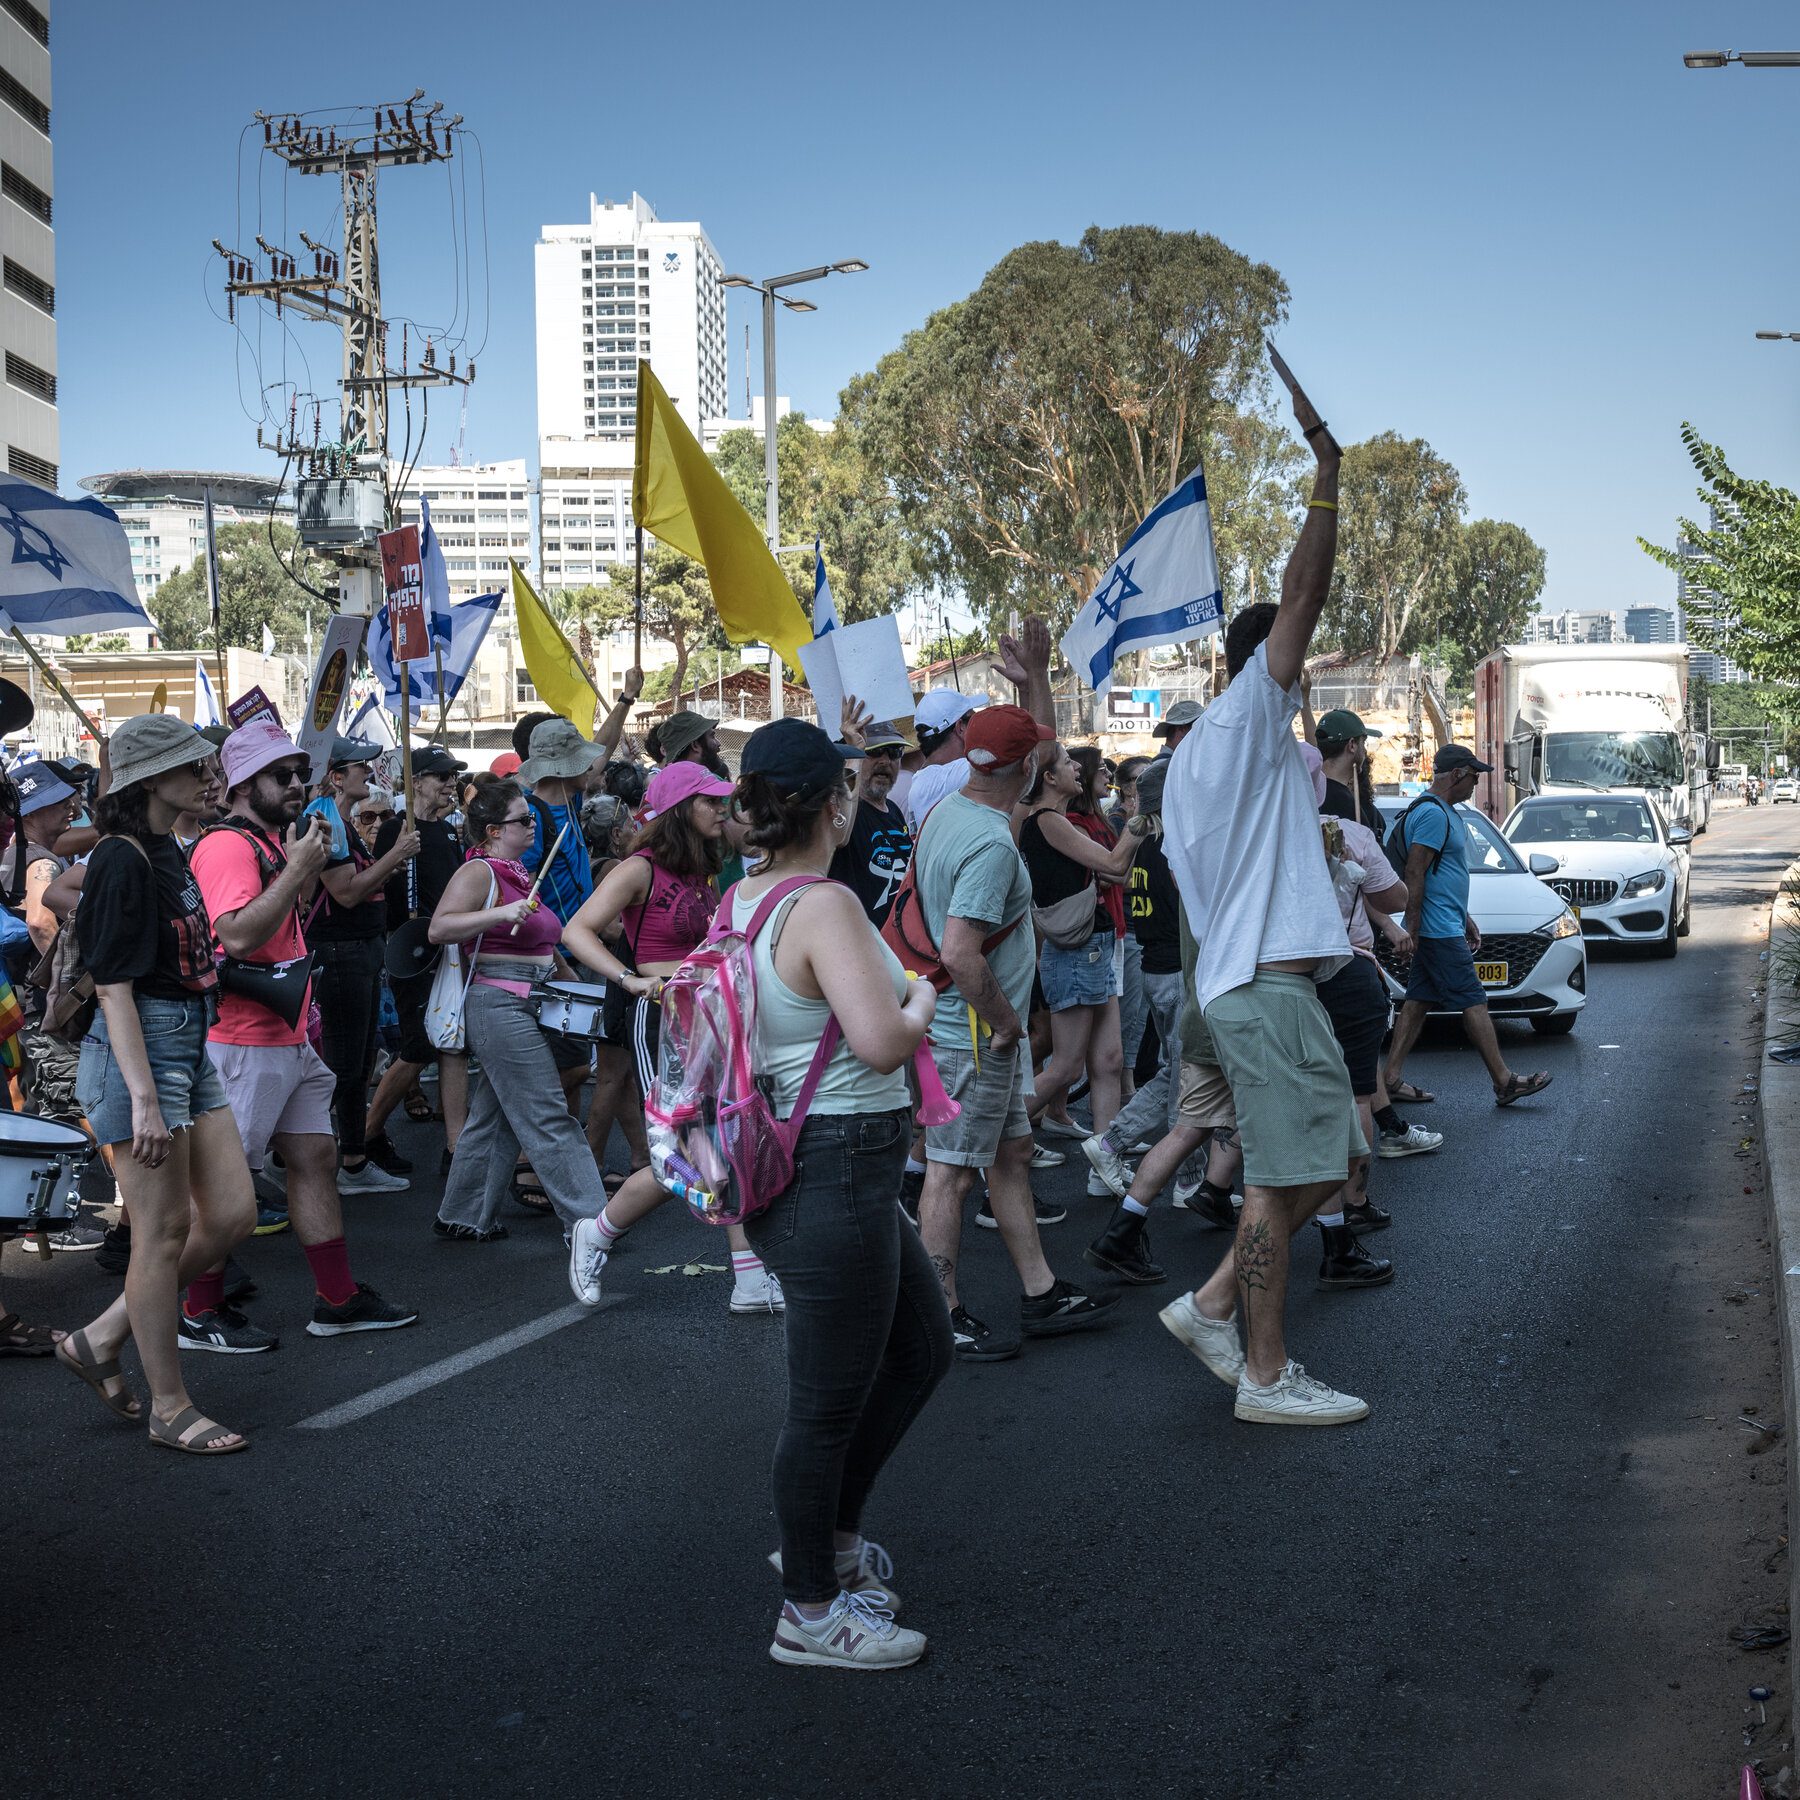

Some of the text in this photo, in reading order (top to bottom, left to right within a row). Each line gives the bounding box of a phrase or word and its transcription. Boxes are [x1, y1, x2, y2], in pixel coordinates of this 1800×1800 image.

[1184, 597, 1215, 614] חופשי
[1186, 607, 1218, 624] בארצנו
[1585, 690, 1651, 699] HINO
[1479, 965, 1502, 980] 803
[829, 1625, 867, 1654] N
